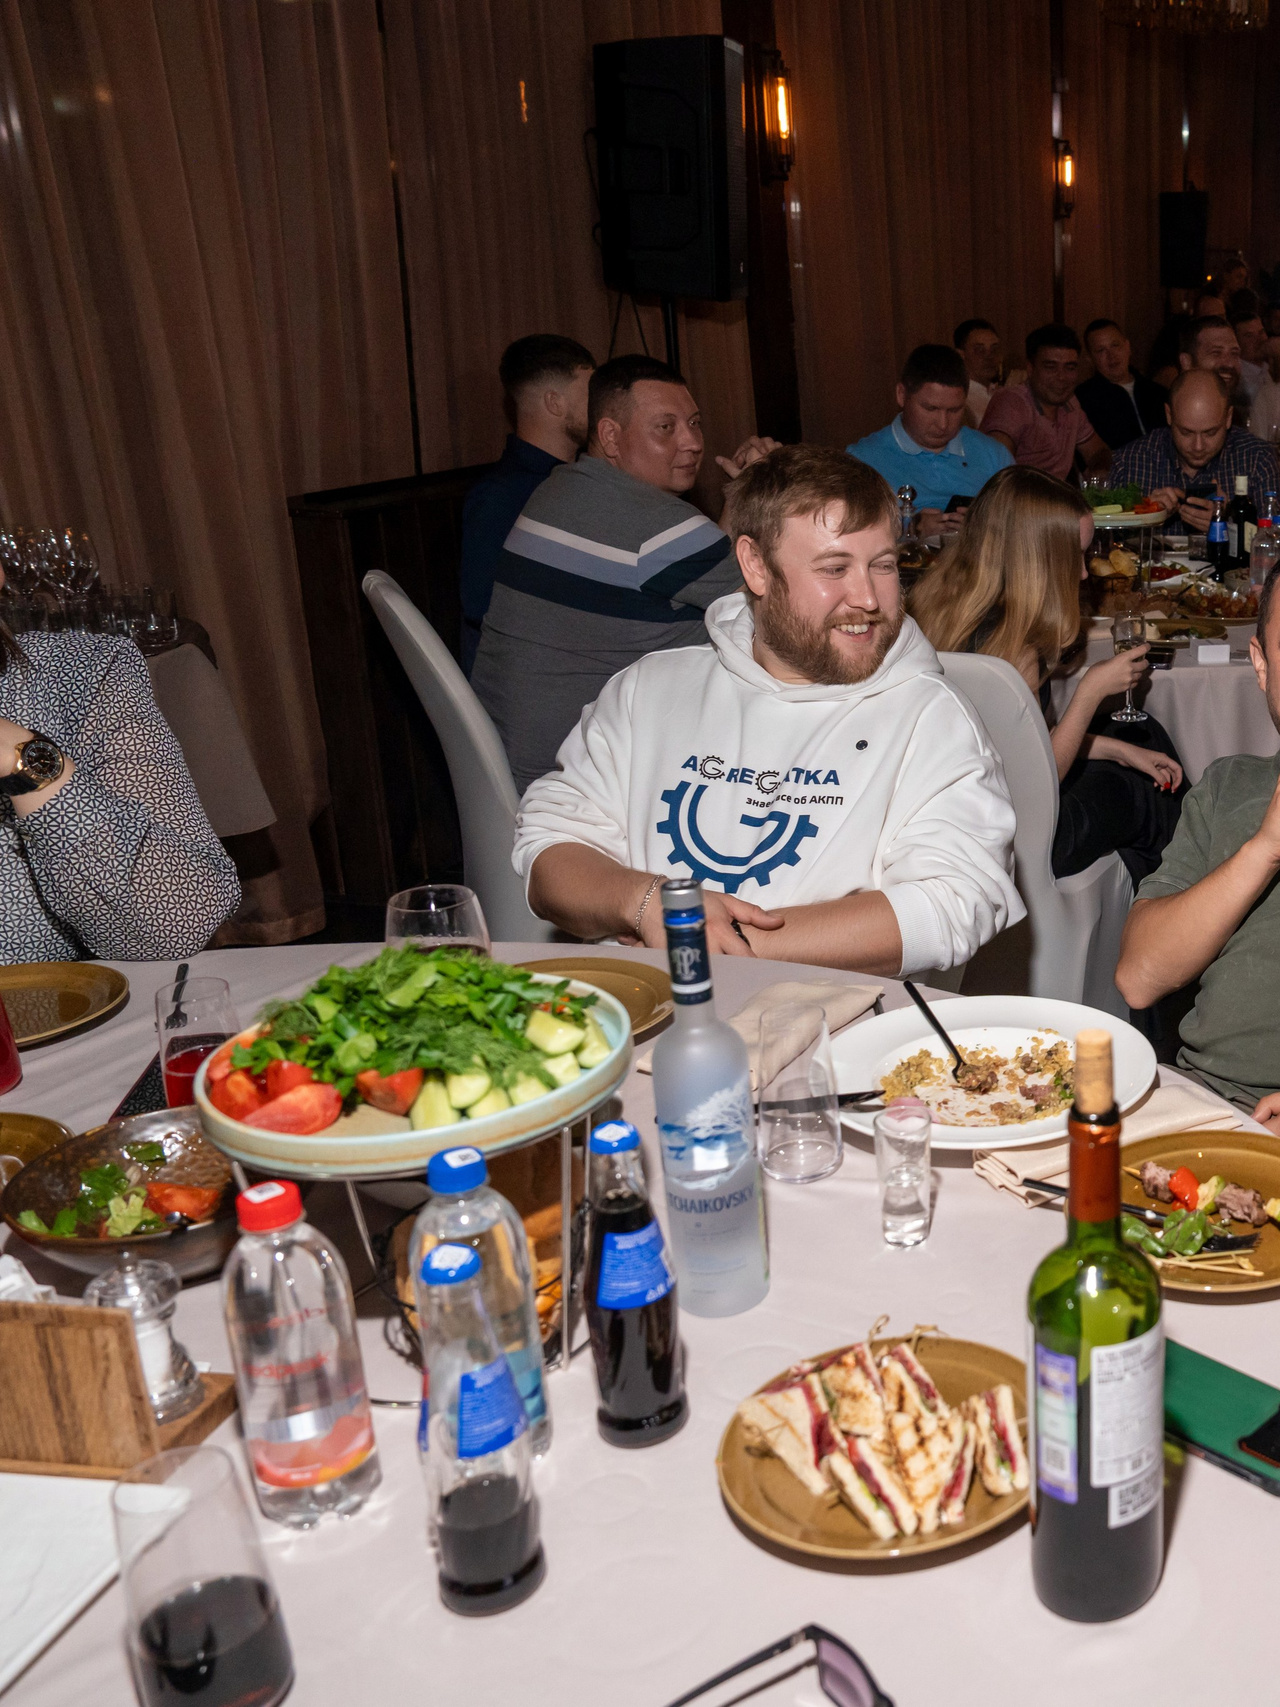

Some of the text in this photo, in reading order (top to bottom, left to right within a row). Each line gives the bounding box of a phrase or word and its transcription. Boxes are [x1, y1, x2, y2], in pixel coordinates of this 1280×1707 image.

[793, 795, 807, 805] об
[809, 795, 844, 806] АКПП
[667, 1184, 755, 1214] TCHAIKOVSKY
